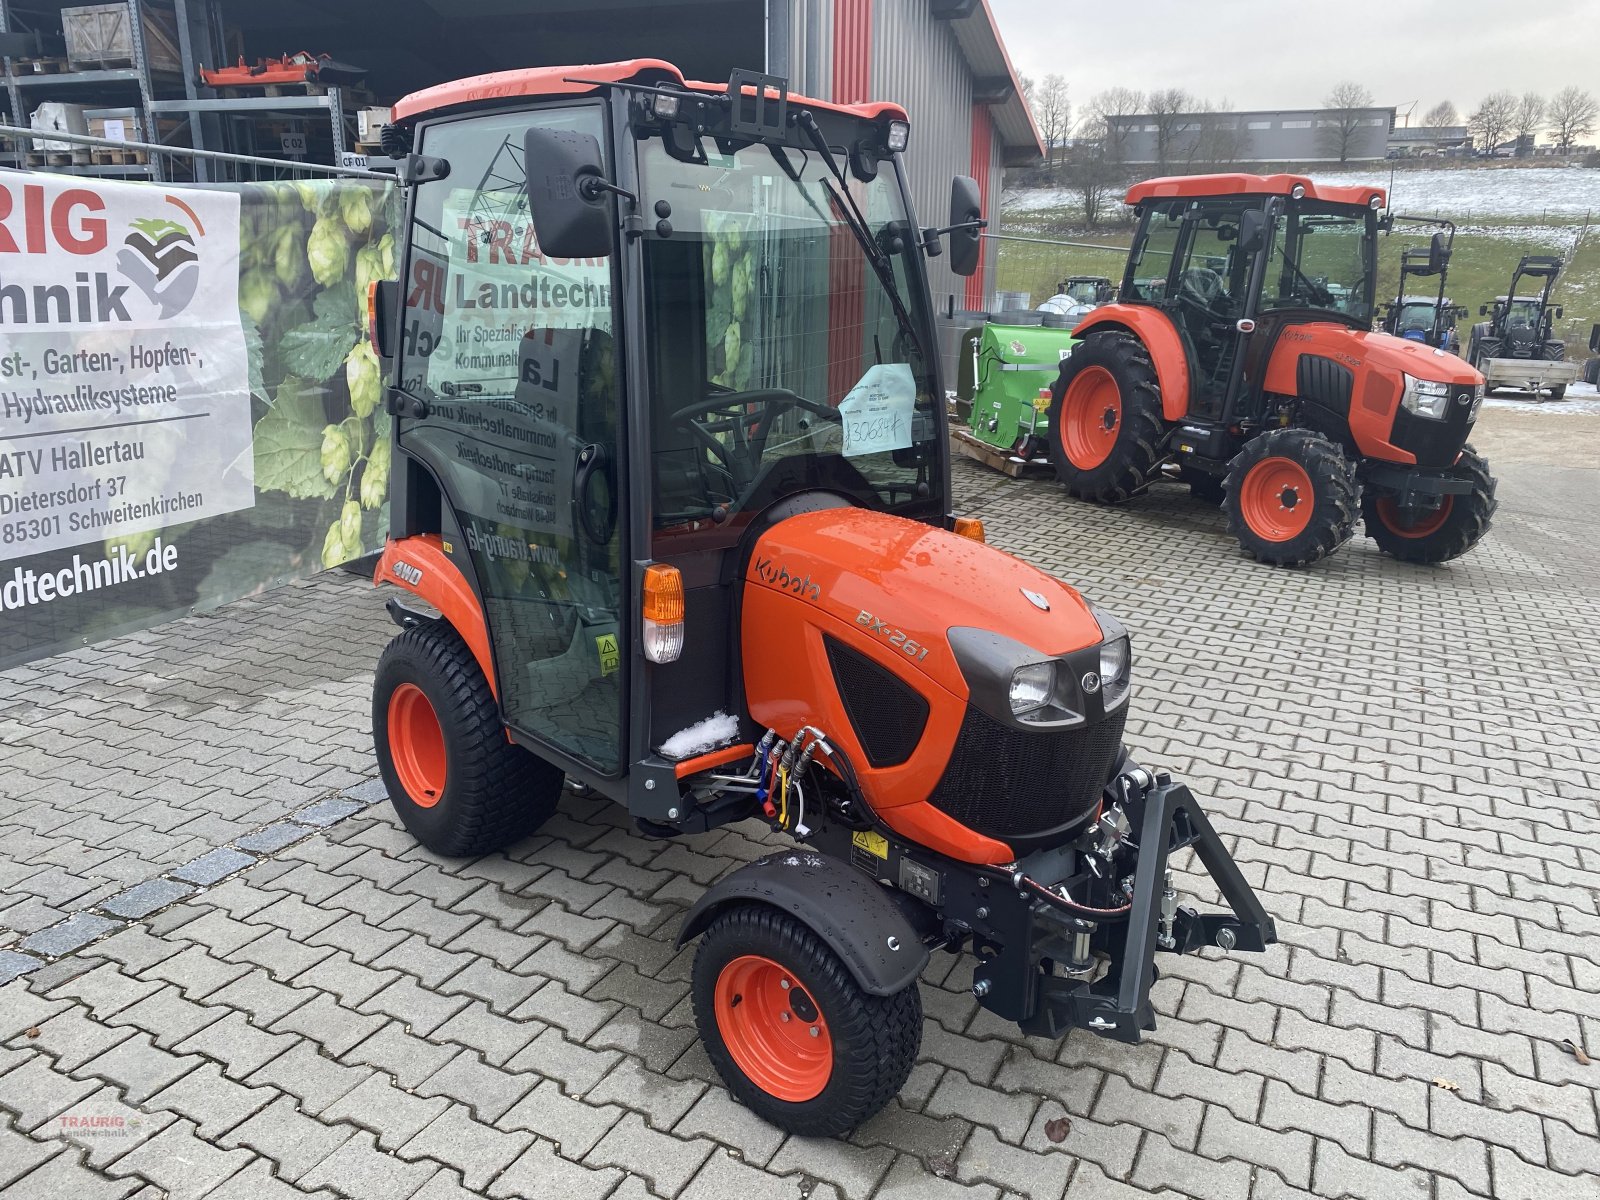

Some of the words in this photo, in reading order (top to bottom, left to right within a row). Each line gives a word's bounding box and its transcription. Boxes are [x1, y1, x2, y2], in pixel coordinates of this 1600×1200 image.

[283, 139, 289, 148] C
[291, 139, 304, 149] 02
[355, 157, 367, 167] 01
[43, 348, 125, 375] Garten-,
[129, 341, 203, 374] Hopfen-,
[2, 383, 177, 424] Hydrauliksysteme
[0, 448, 43, 479] ATV
[51, 441, 144, 472] Hallertau
[1, 479, 101, 515] Dietersdorf
[107, 476, 127, 497] 37
[2, 514, 61, 544] 85301
[68, 491, 203, 532] Schweitenkirchen
[0, 536, 178, 613] dtechnik.de
[391, 560, 424, 587] 4WD
[755, 556, 821, 601] Kubota
[855, 609, 929, 662] BX-261
